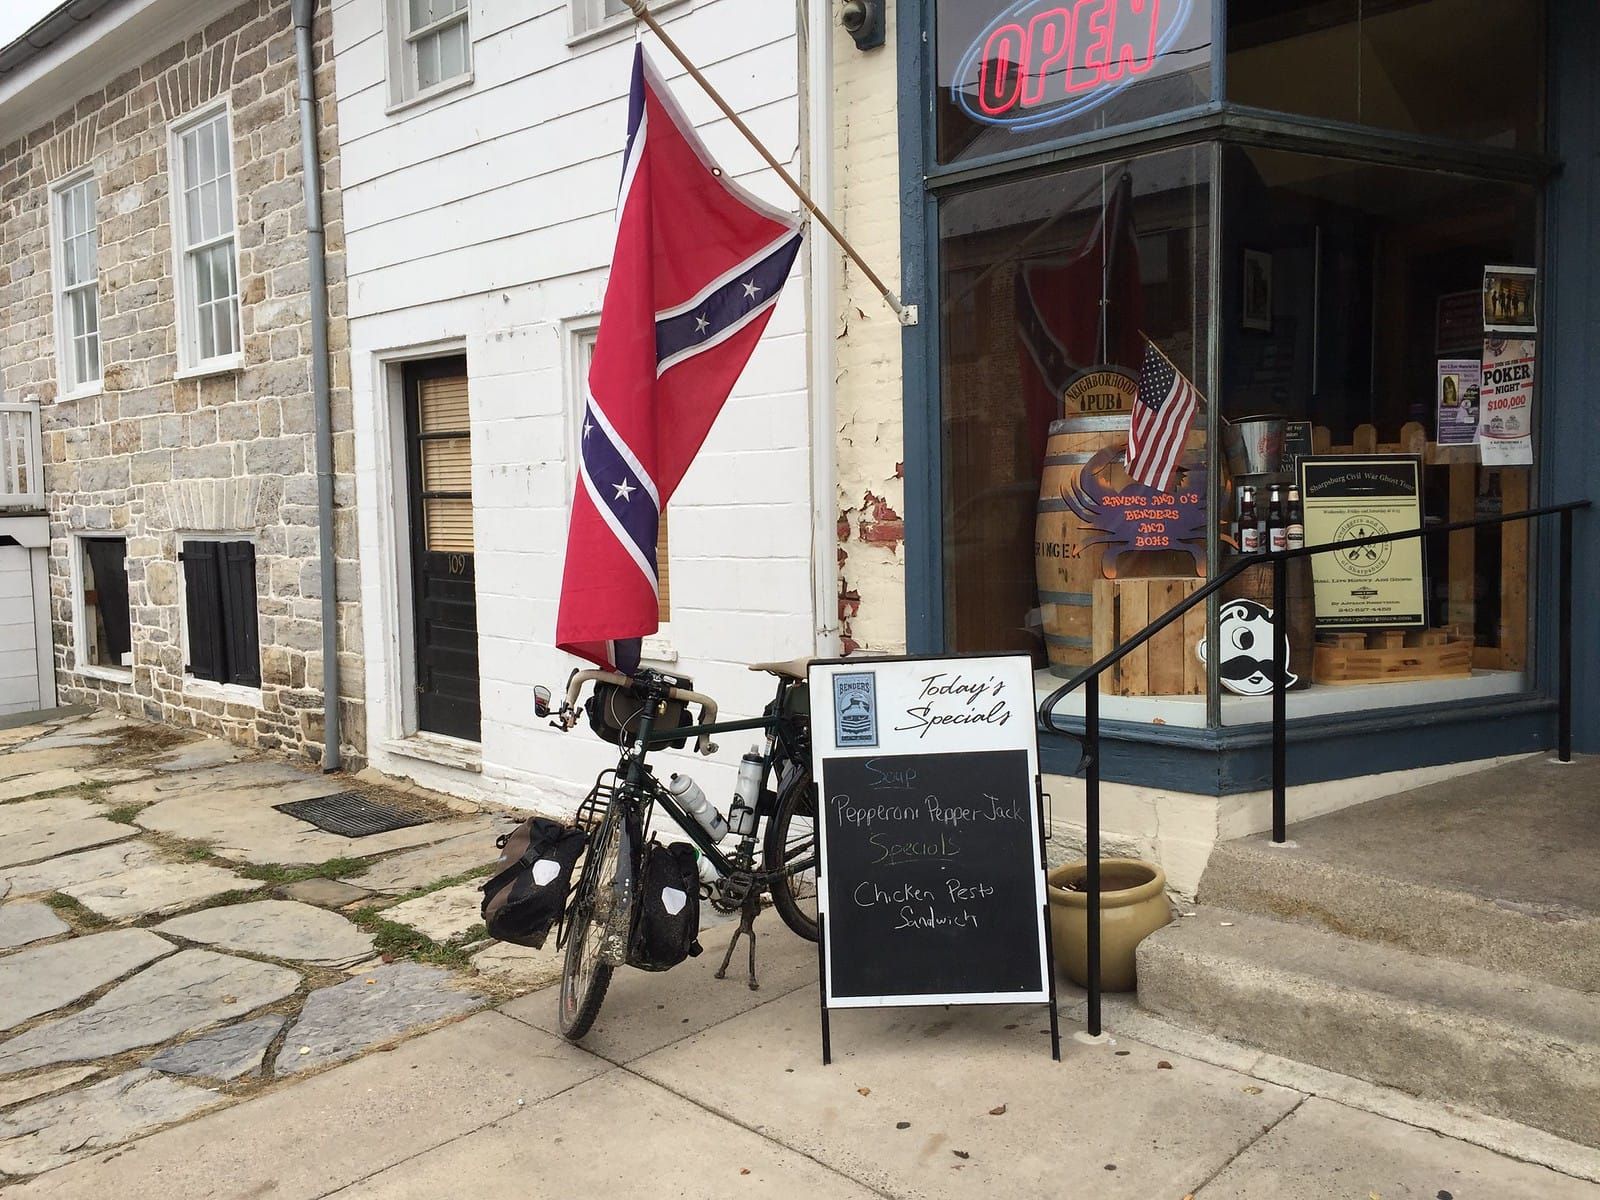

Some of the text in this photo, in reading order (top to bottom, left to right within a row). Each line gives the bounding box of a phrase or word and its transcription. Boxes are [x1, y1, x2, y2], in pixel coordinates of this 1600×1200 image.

[978, 0, 1160, 115] OPEN
[1483, 364, 1531, 386] POKER
[1066, 373, 1137, 401] NEIGHBORHOOD
[1495, 383, 1521, 395] NIGHT
[1087, 394, 1115, 411] PUB
[1487, 395, 1527, 411] $100,000
[1309, 475, 1346, 494] Sharpsburg
[1346, 472, 1361, 481] Civil
[1364, 471, 1380, 480] War
[1380, 473, 1398, 484] Ghost
[1151, 494, 1175, 506] AND
[1180, 493, 1198, 504] O'S
[1124, 509, 1179, 521] BENDERS
[1138, 523, 1165, 533] AND
[1135, 536, 1169, 547] BOHS
[448, 554, 465, 575] 109
[840, 682, 870, 695] BENDERS
[919, 673, 1006, 705] Today's
[894, 700, 1010, 738] Specials
[865, 758, 917, 788] Soup
[831, 794, 919, 827] Pepperoni
[854, 878, 994, 907] Chicken Pesto
[894, 906, 978, 929] Sandwich
